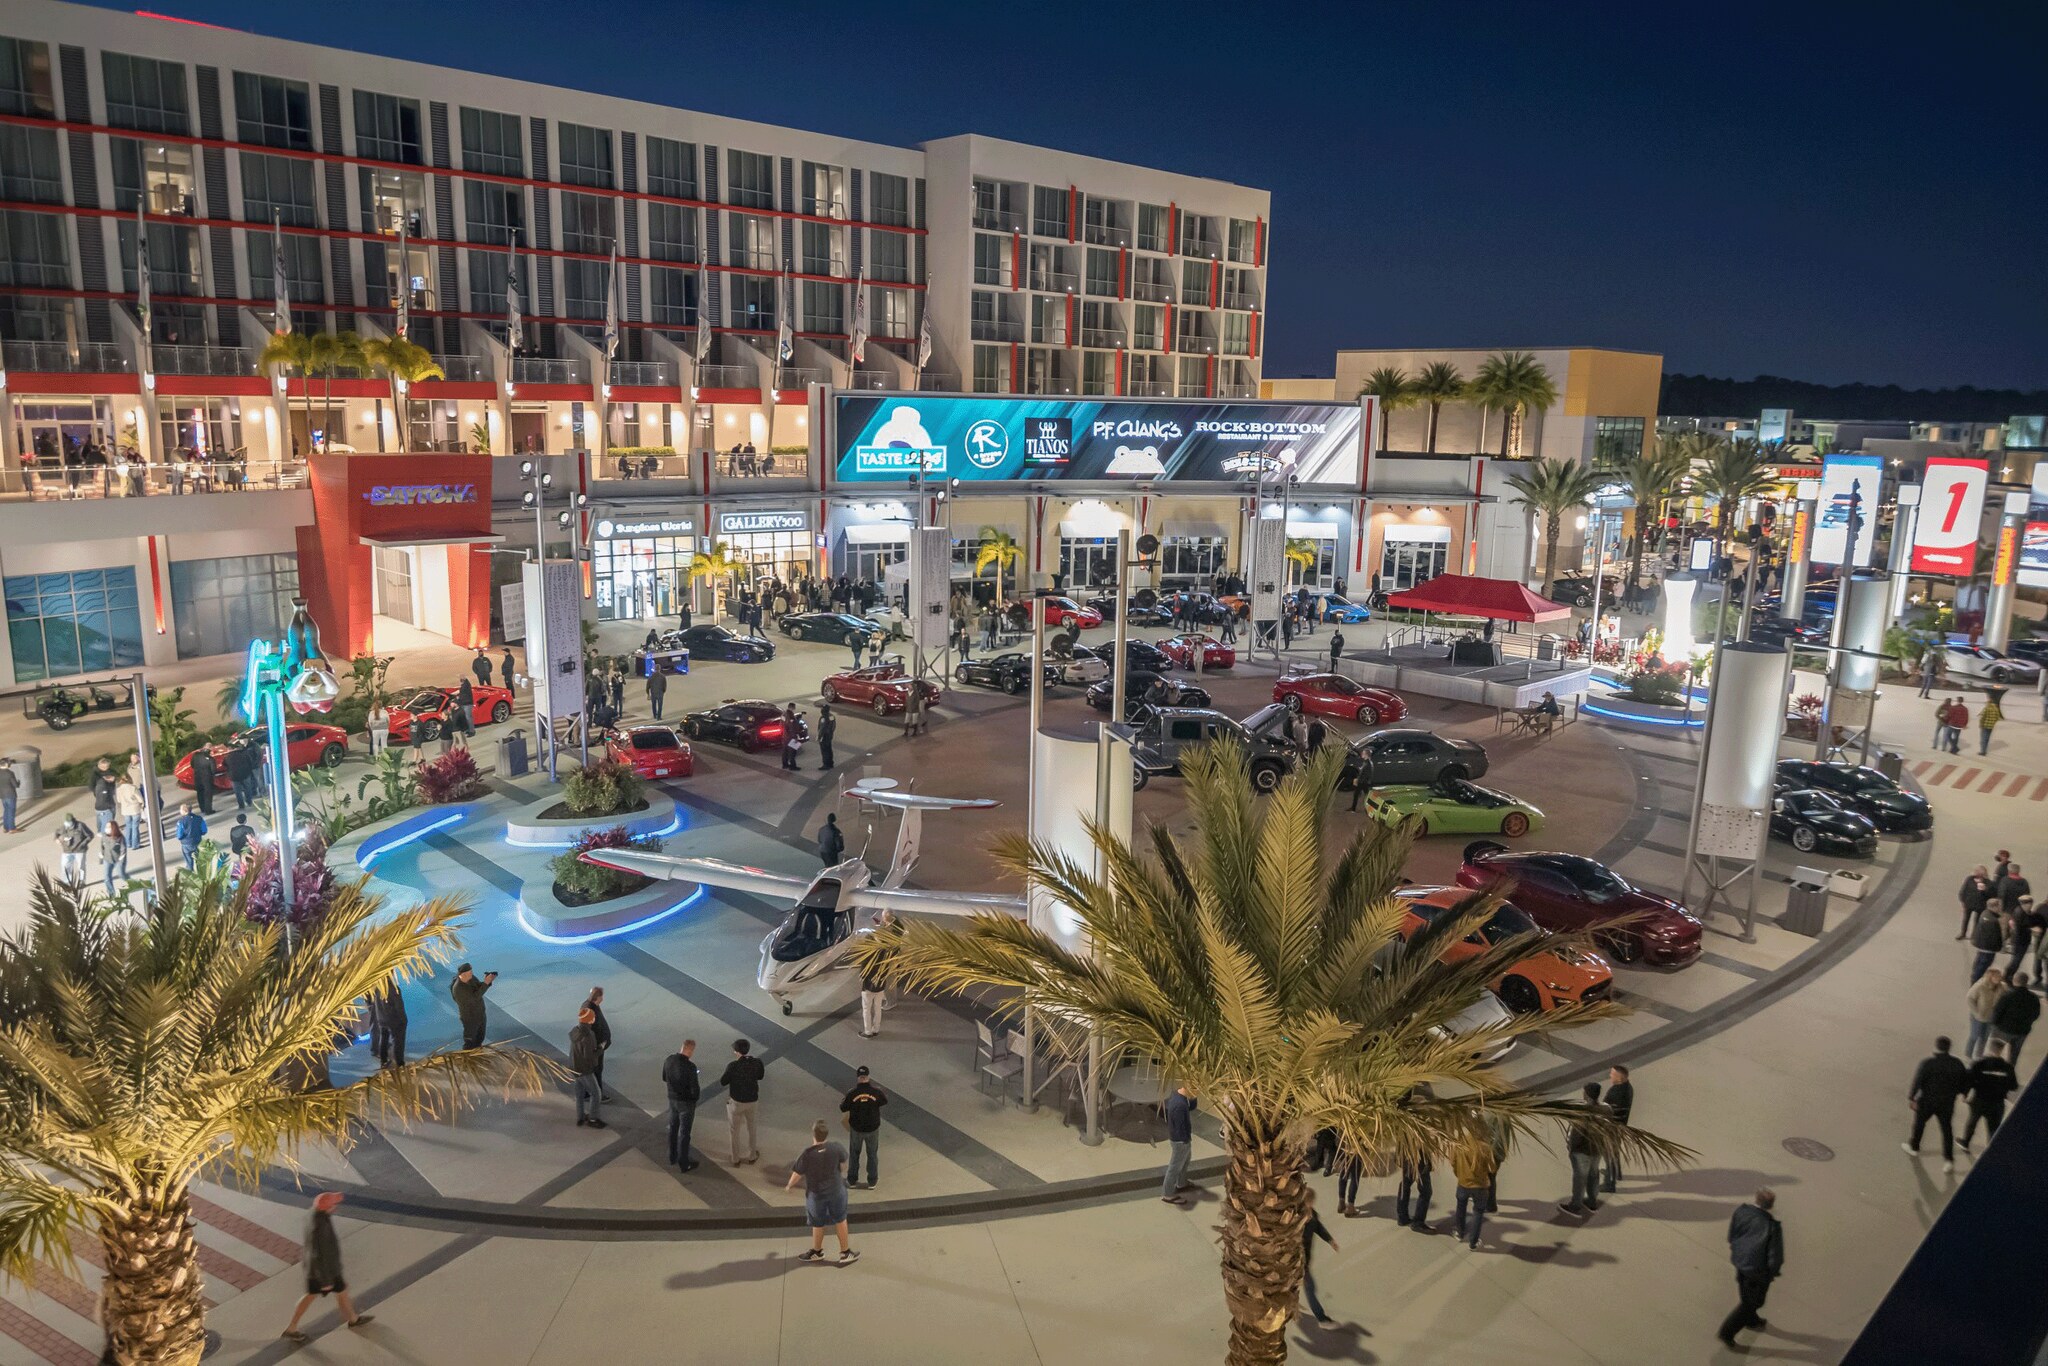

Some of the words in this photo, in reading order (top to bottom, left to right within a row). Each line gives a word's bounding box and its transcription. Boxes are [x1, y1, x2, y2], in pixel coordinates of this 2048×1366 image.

[1025, 438, 1069, 454] TIANOS
[860, 451, 903, 466] TASTE
[1941, 481, 1970, 533] 1
